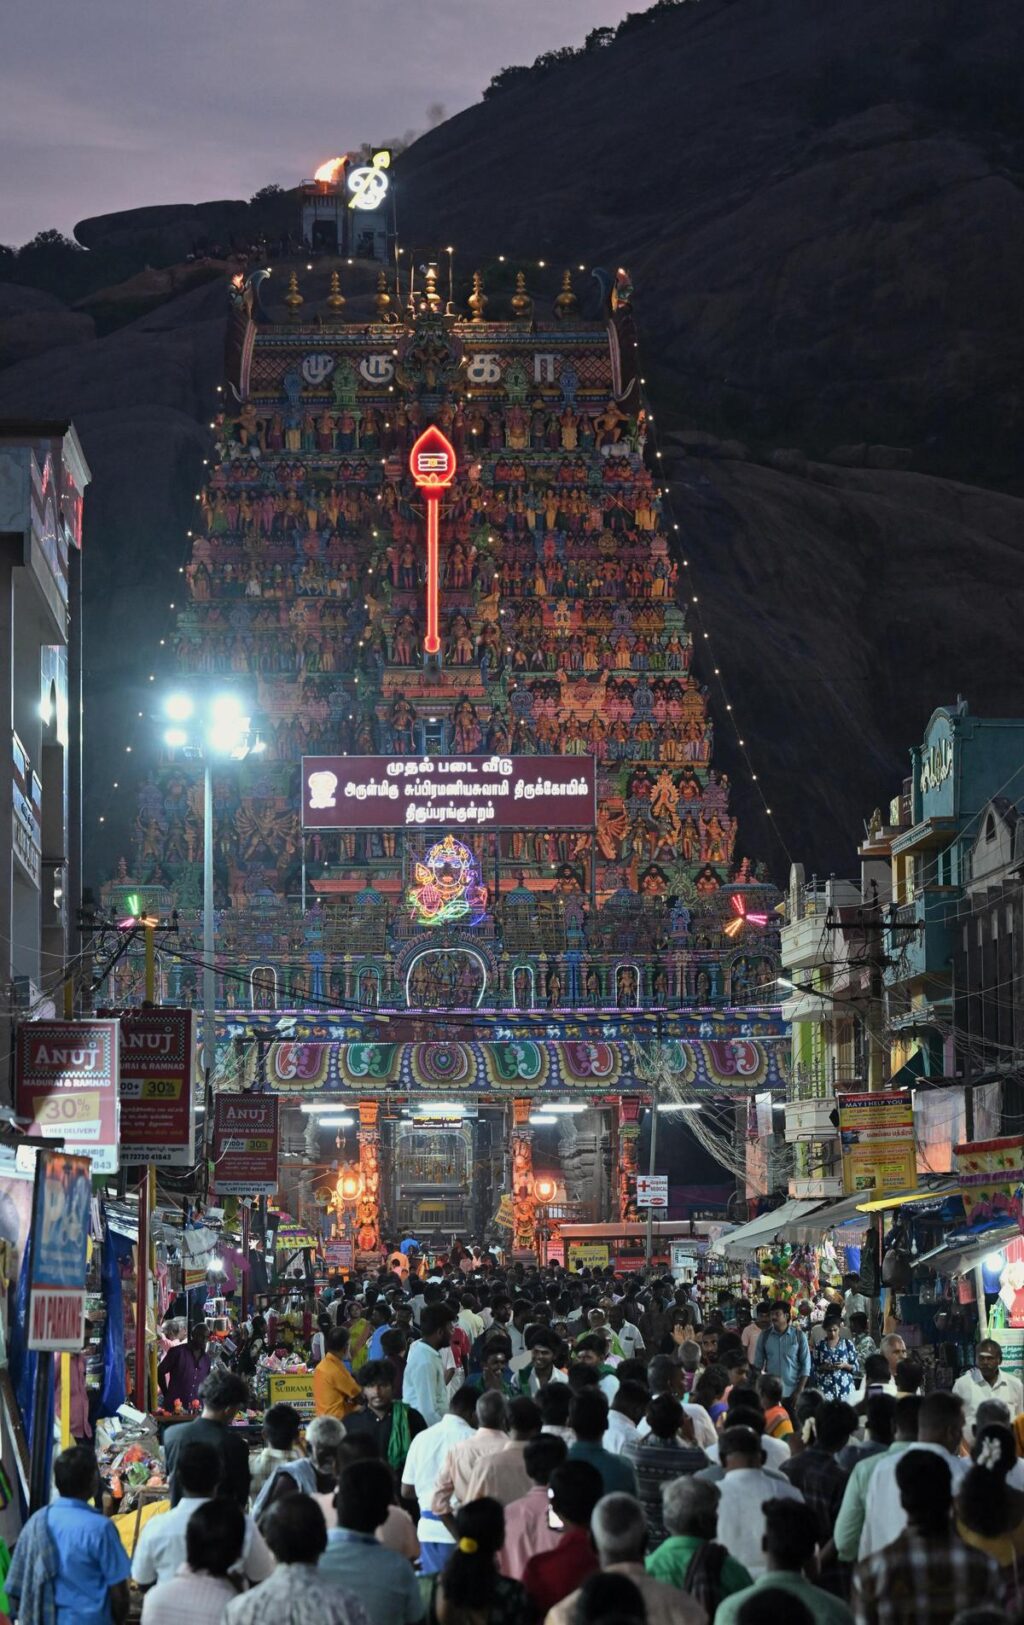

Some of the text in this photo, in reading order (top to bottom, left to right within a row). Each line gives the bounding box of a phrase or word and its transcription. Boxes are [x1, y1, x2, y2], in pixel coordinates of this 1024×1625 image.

[386, 756, 513, 776] முதல் படை வீடு
[344, 777, 588, 800] அருள்மிகு சுப்பிரமணியசுவாமி திருக்கோயில்
[405, 801, 495, 824] திருப்பரங்குன்றம்
[23, 1079, 112, 1087] MADURAI & RAMNAD
[46, 1097, 91, 1119] 30%
[33, 1295, 82, 1340] NO PARKING
